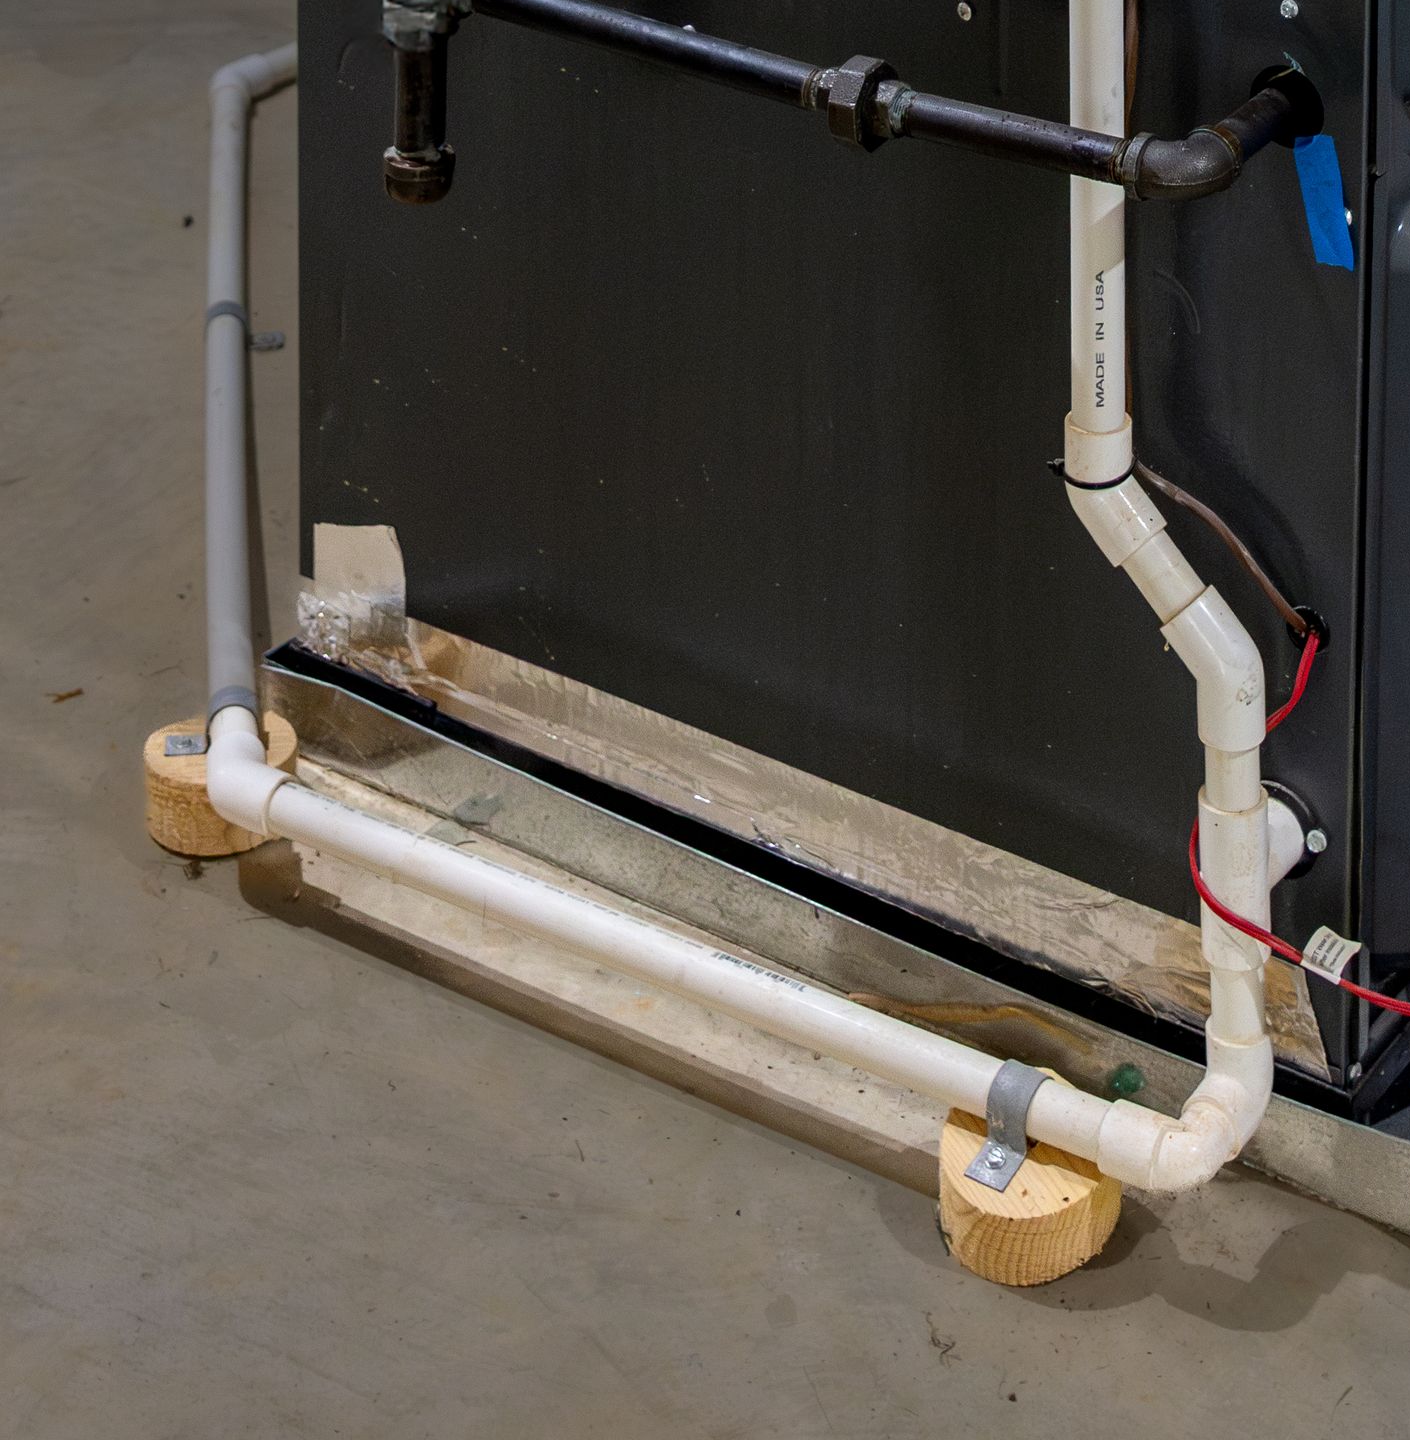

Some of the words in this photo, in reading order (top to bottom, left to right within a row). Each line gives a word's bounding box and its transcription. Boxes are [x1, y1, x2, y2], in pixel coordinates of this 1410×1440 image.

[1095, 271, 1105, 311] USA
[1096, 323, 1105, 341] IN
[1096, 353, 1105, 408] MADE
